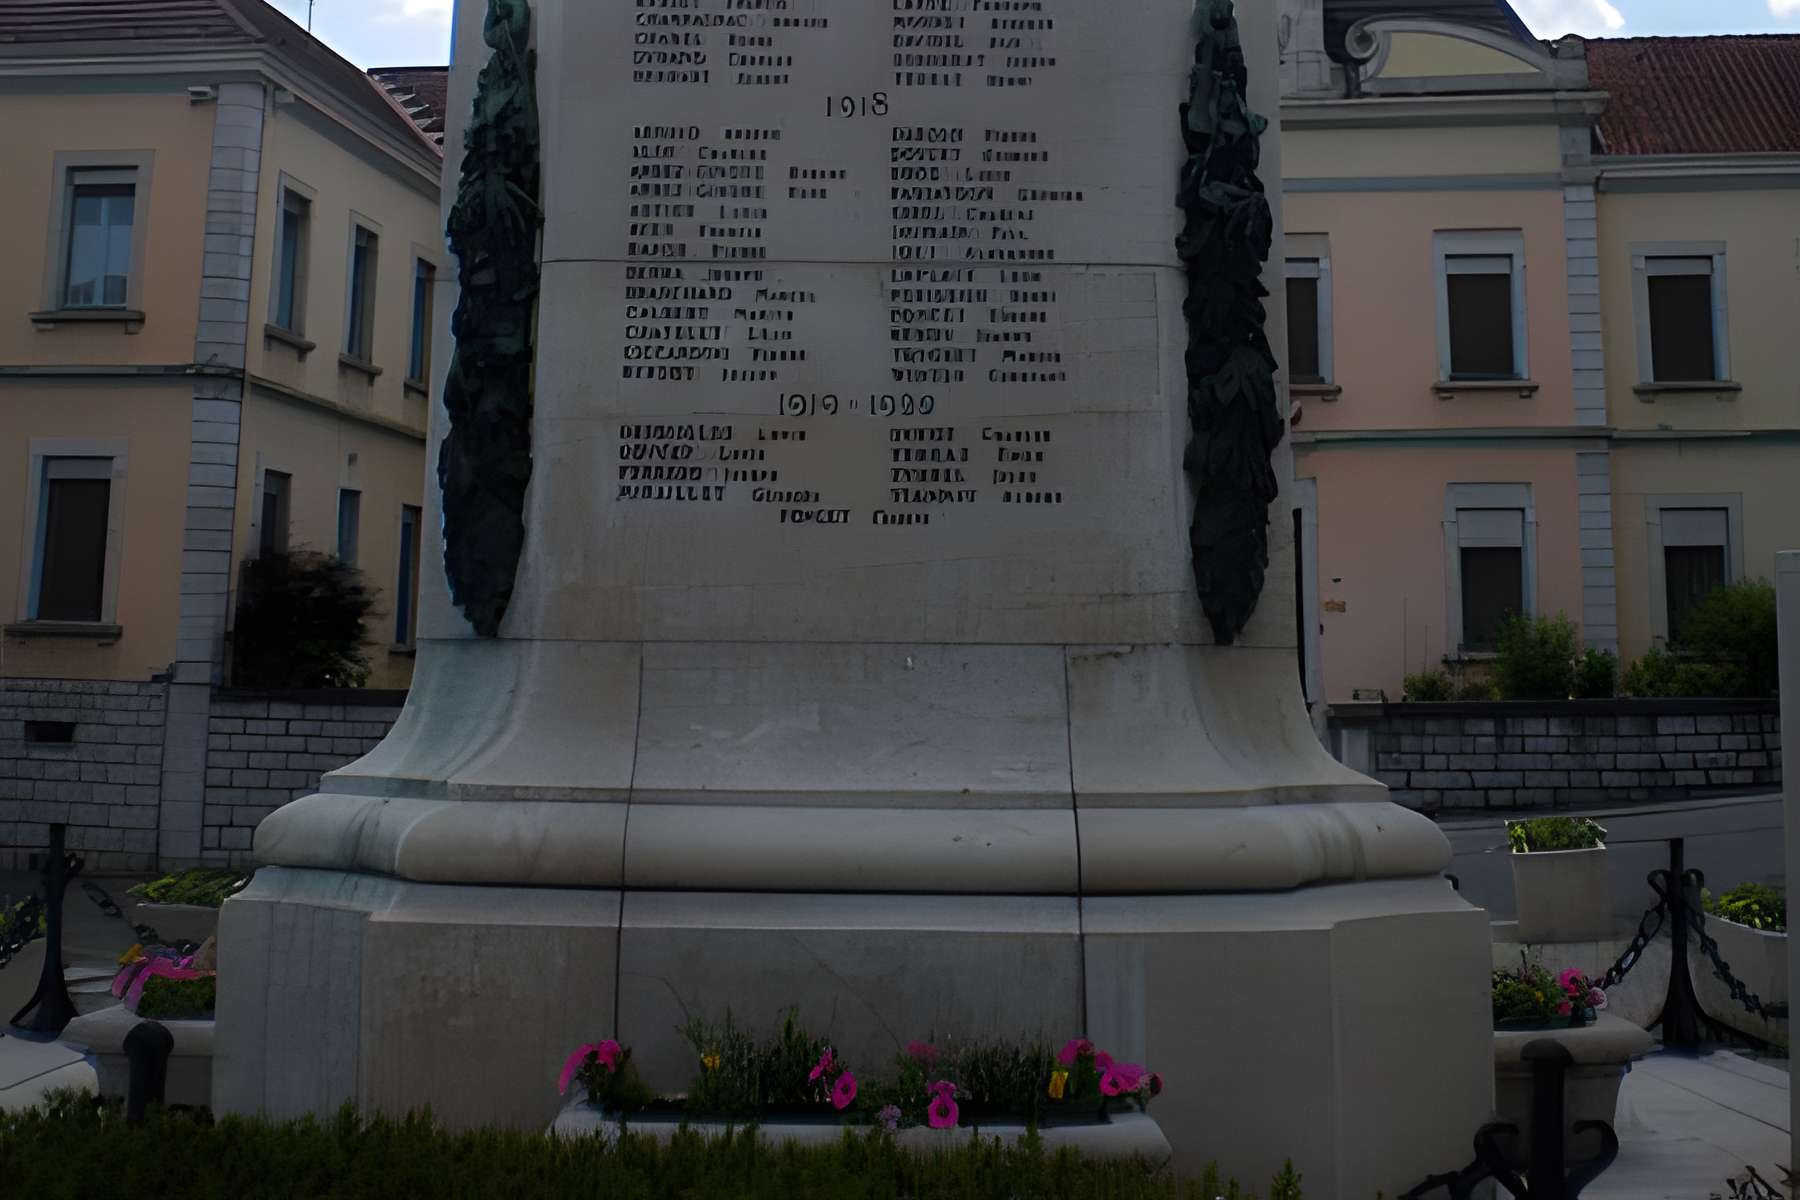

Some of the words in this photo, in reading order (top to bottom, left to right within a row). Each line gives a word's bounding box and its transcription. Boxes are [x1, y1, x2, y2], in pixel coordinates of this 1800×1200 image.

[826, 92, 888, 118] 1918
[780, 393, 838, 416] 1919
[871, 393, 934, 416] 1920
